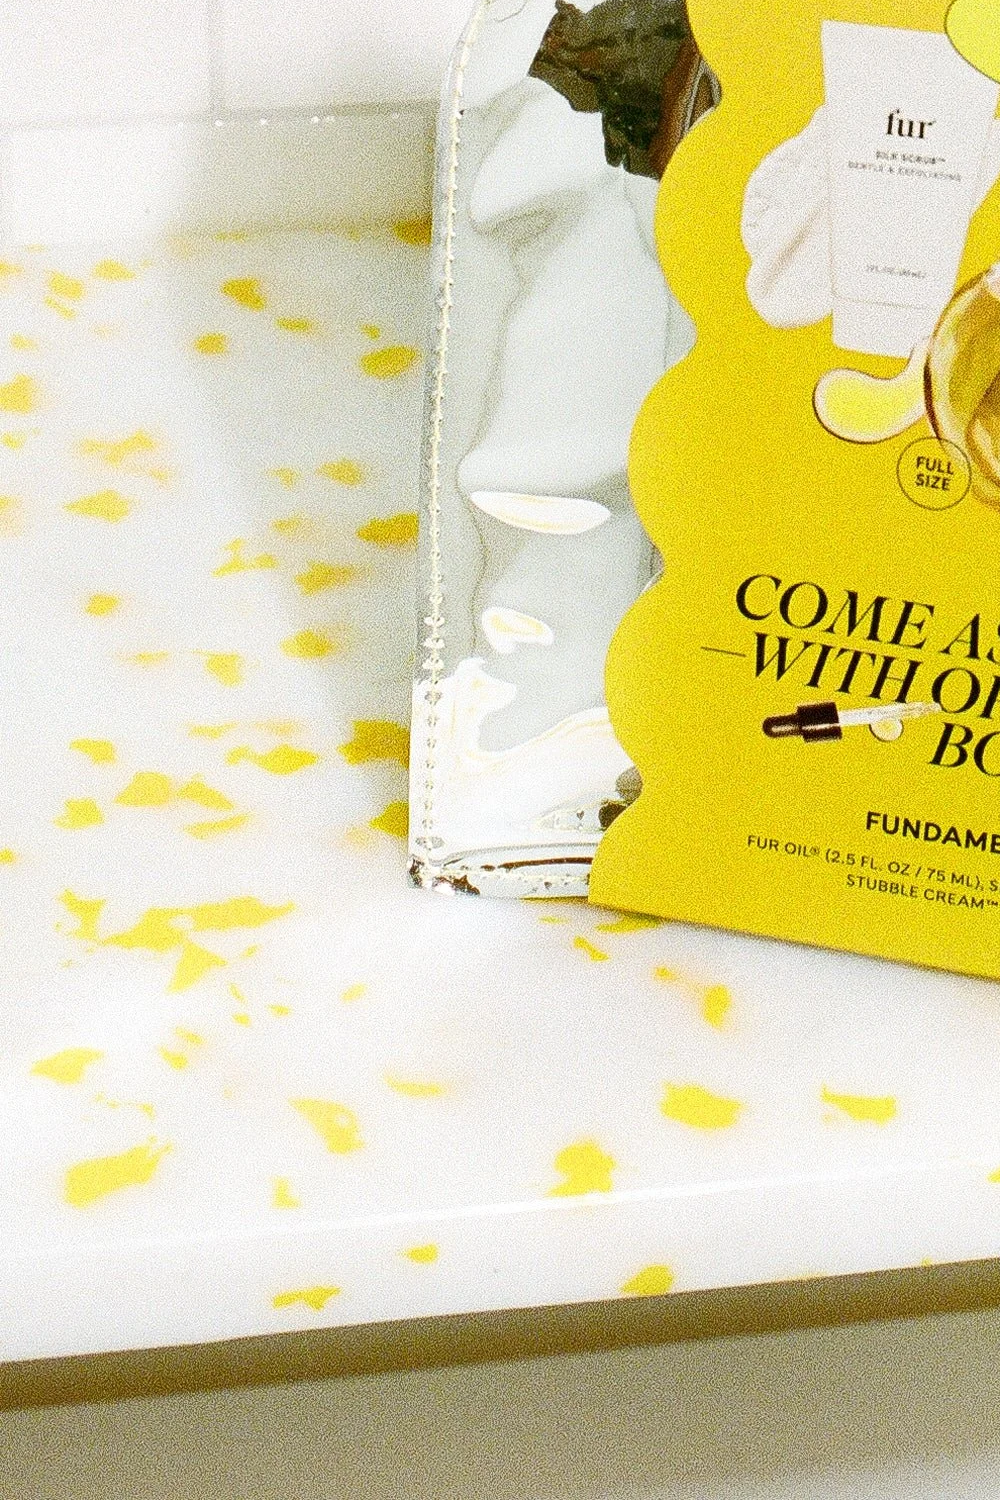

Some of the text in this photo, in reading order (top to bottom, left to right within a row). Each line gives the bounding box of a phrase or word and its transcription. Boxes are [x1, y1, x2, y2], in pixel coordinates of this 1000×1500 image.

[886, 108, 934, 139] fur
[916, 455, 954, 475] FULL
[915, 473, 951, 491] SIZE
[736, 573, 935, 650] COME
[747, 834, 779, 851] FUR
[825, 847, 856, 866] (2.5
[860, 855, 883, 871] FL.
[887, 861, 911, 877] OZ
[927, 867, 946, 883] 75
[846, 873, 918, 898] STUBBLE
